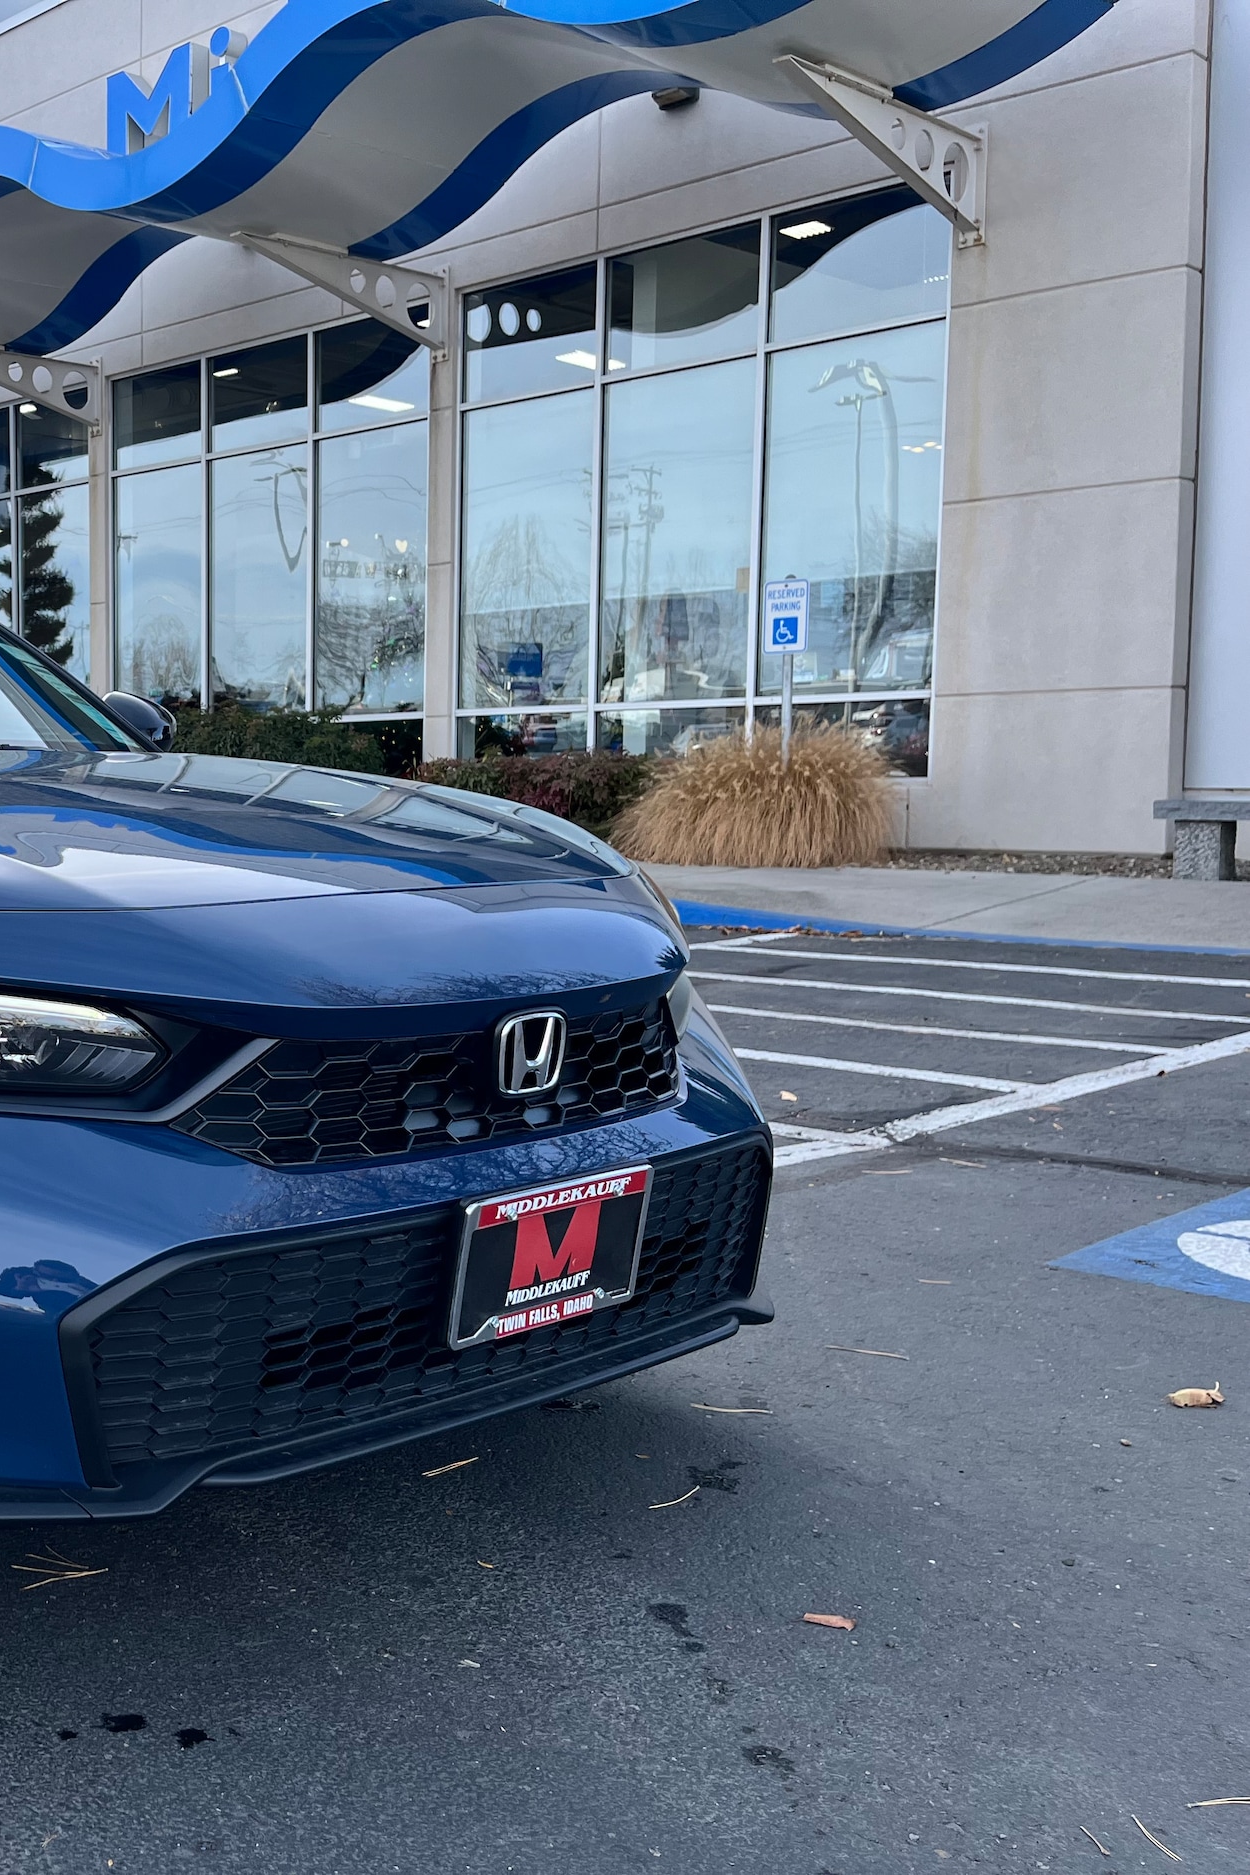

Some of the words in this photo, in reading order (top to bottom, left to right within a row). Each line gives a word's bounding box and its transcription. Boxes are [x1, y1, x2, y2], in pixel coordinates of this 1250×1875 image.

[768, 588, 805, 600] RESERVED
[771, 602, 801, 612] PARKING
[495, 1177, 632, 1219] MIDDLEKAUFF
[504, 1270, 590, 1307] MIDDLEKAUFF
[498, 1314, 526, 1334] TWIN
[528, 1305, 561, 1326] FALLS,
[563, 1294, 593, 1317] IDAHO
